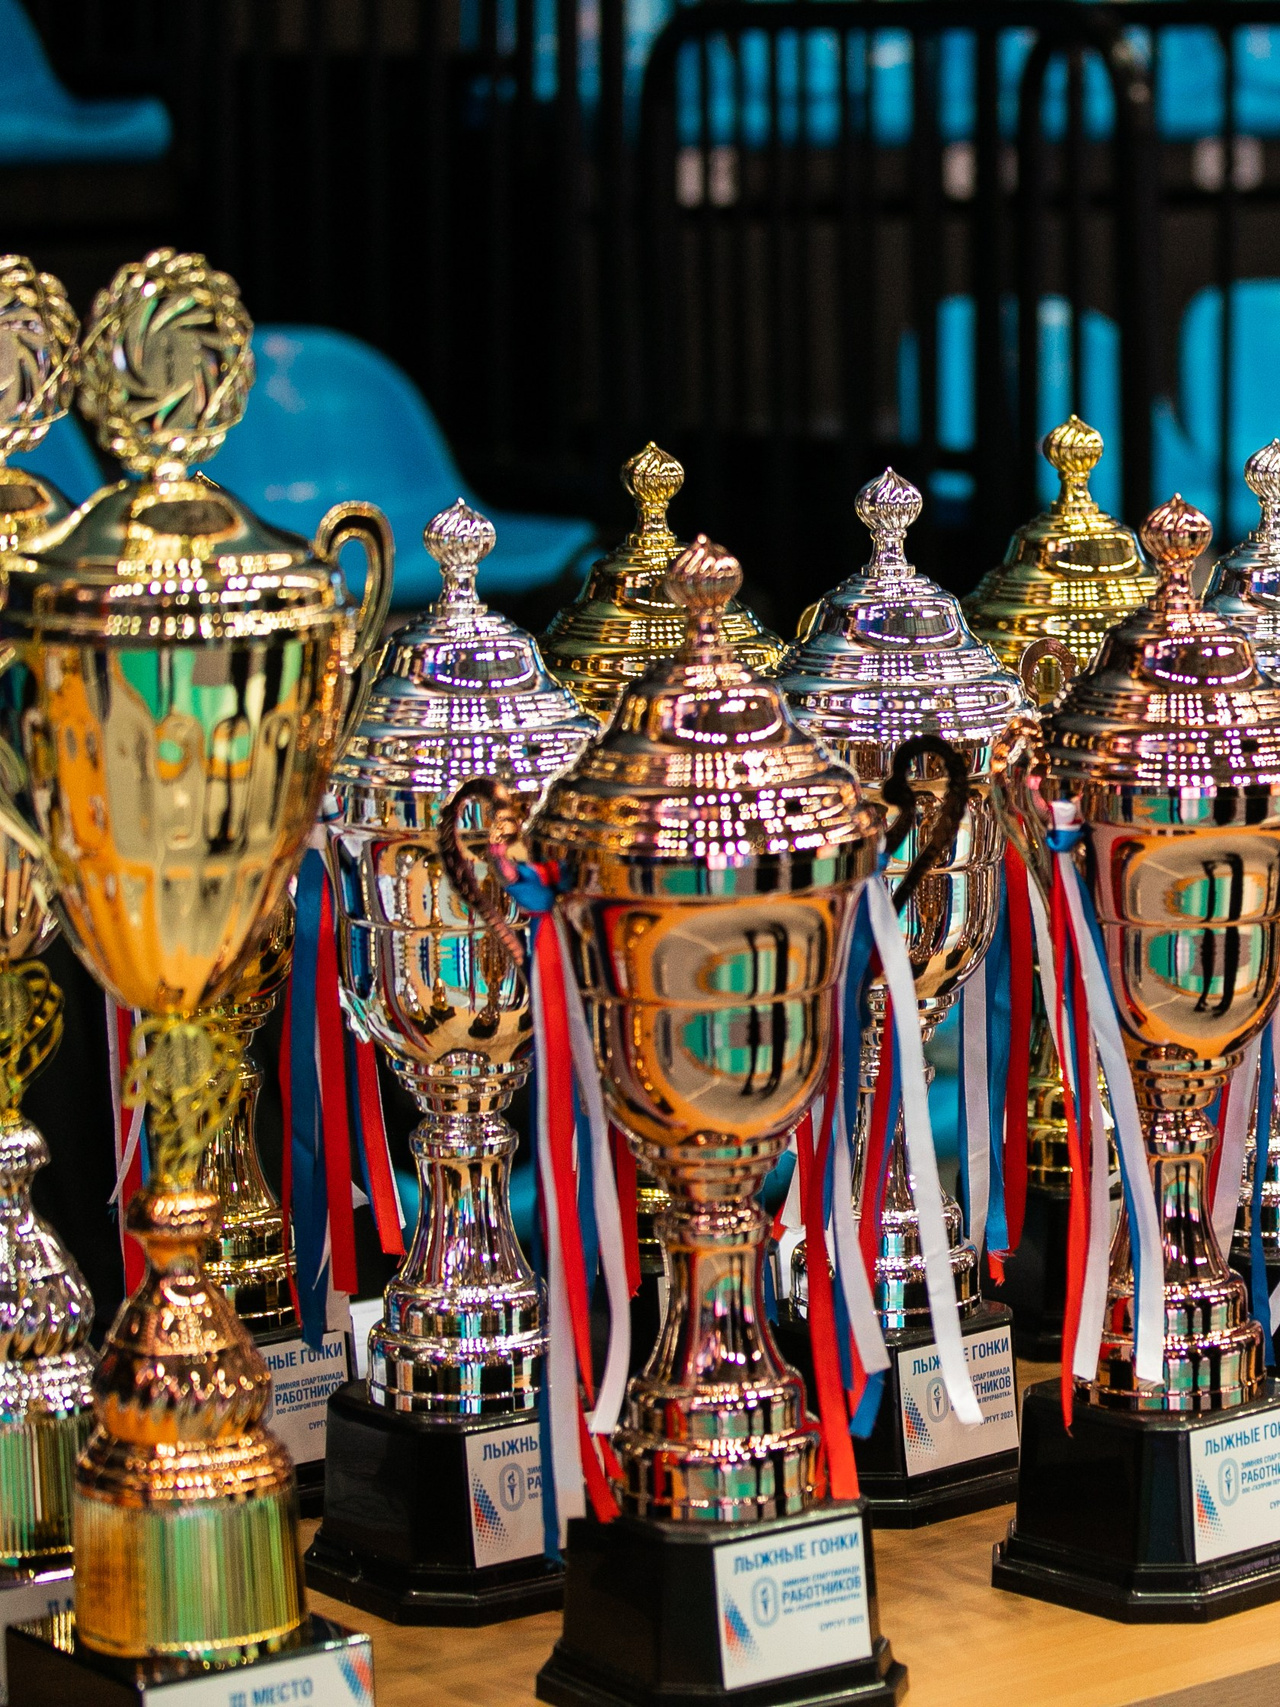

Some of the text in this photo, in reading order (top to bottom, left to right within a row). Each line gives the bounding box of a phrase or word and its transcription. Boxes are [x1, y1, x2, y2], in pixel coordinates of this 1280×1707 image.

[266, 1341, 343, 1371] НЫЕ ГОНКИ
[912, 1337, 1010, 1376] ЛЫЖЕ ГОНКИ
[274, 1371, 345, 1393] ЗИМНЯЯ СПАРТАКИАДА
[972, 1366, 1011, 1383] СПАРТАКИАДА
[974, 1375, 1012, 1396] ТНИКОВ
[1000, 1410, 1014, 1420] 2023
[482, 1434, 541, 1461] ЛЫЖНЫ
[1204, 1426, 1260, 1456] ЛЫЖНЫЕ
[733, 1531, 860, 1575] ЛЫЖНЫЕ ГОНКИ
[781, 1575, 862, 1604] РАБОТНИКОВ
[252, 1676, 313, 1705] МЕСТО
